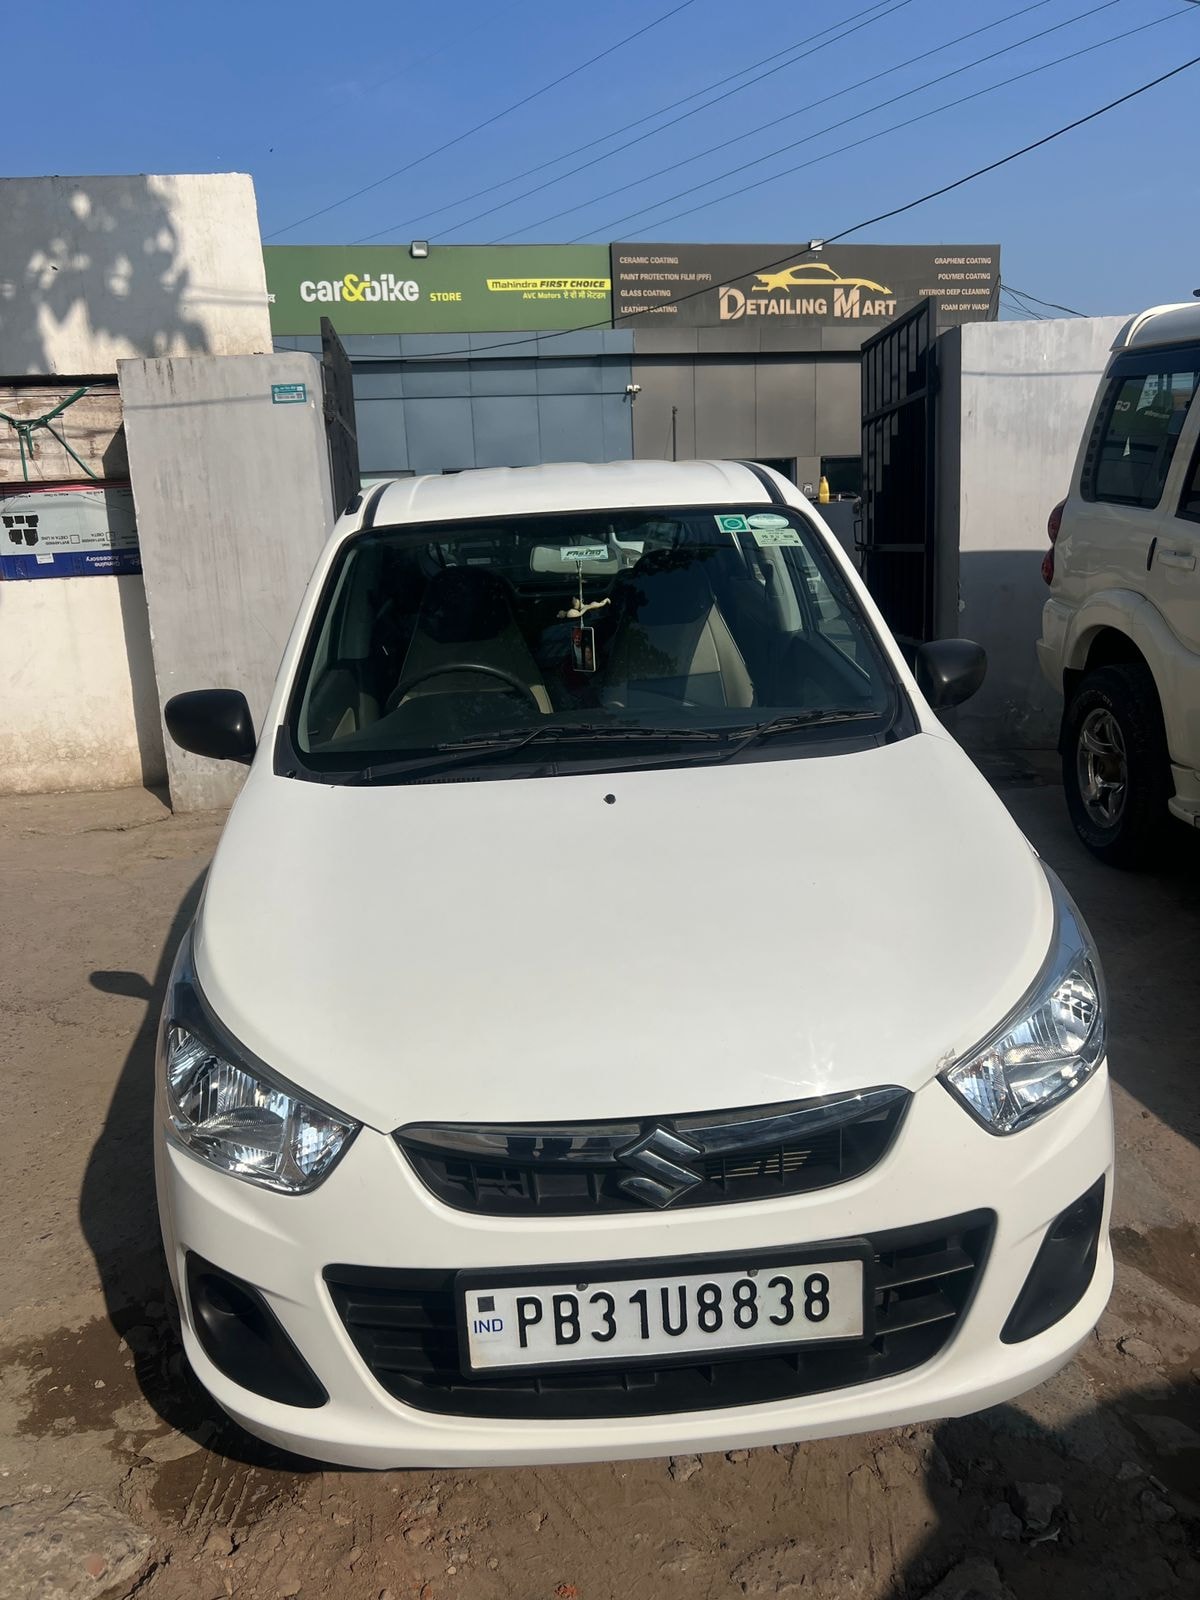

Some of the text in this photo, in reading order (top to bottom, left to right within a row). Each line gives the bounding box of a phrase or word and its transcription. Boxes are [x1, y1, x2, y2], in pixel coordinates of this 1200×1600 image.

[619, 256, 679, 264] CERAMIC COATING
[934, 257, 992, 265] GRAPHENE COATING
[620, 273, 712, 281] PAINT PROTECTION FILM (PPF)
[937, 272, 991, 281] POLYMER COATING
[300, 273, 462, 302] car&bike STORE
[540, 280, 569, 288] FIRST
[570, 280, 606, 288] CHOICE
[620, 289, 672, 297] GLASS COATING
[919, 288, 945, 296] INTERIOR
[946, 288, 961, 296] DEEP
[620, 305, 649, 313] LEATHER
[971, 303, 990, 311] WASH
[472, 1271, 831, 1349] IND PB31U8838
